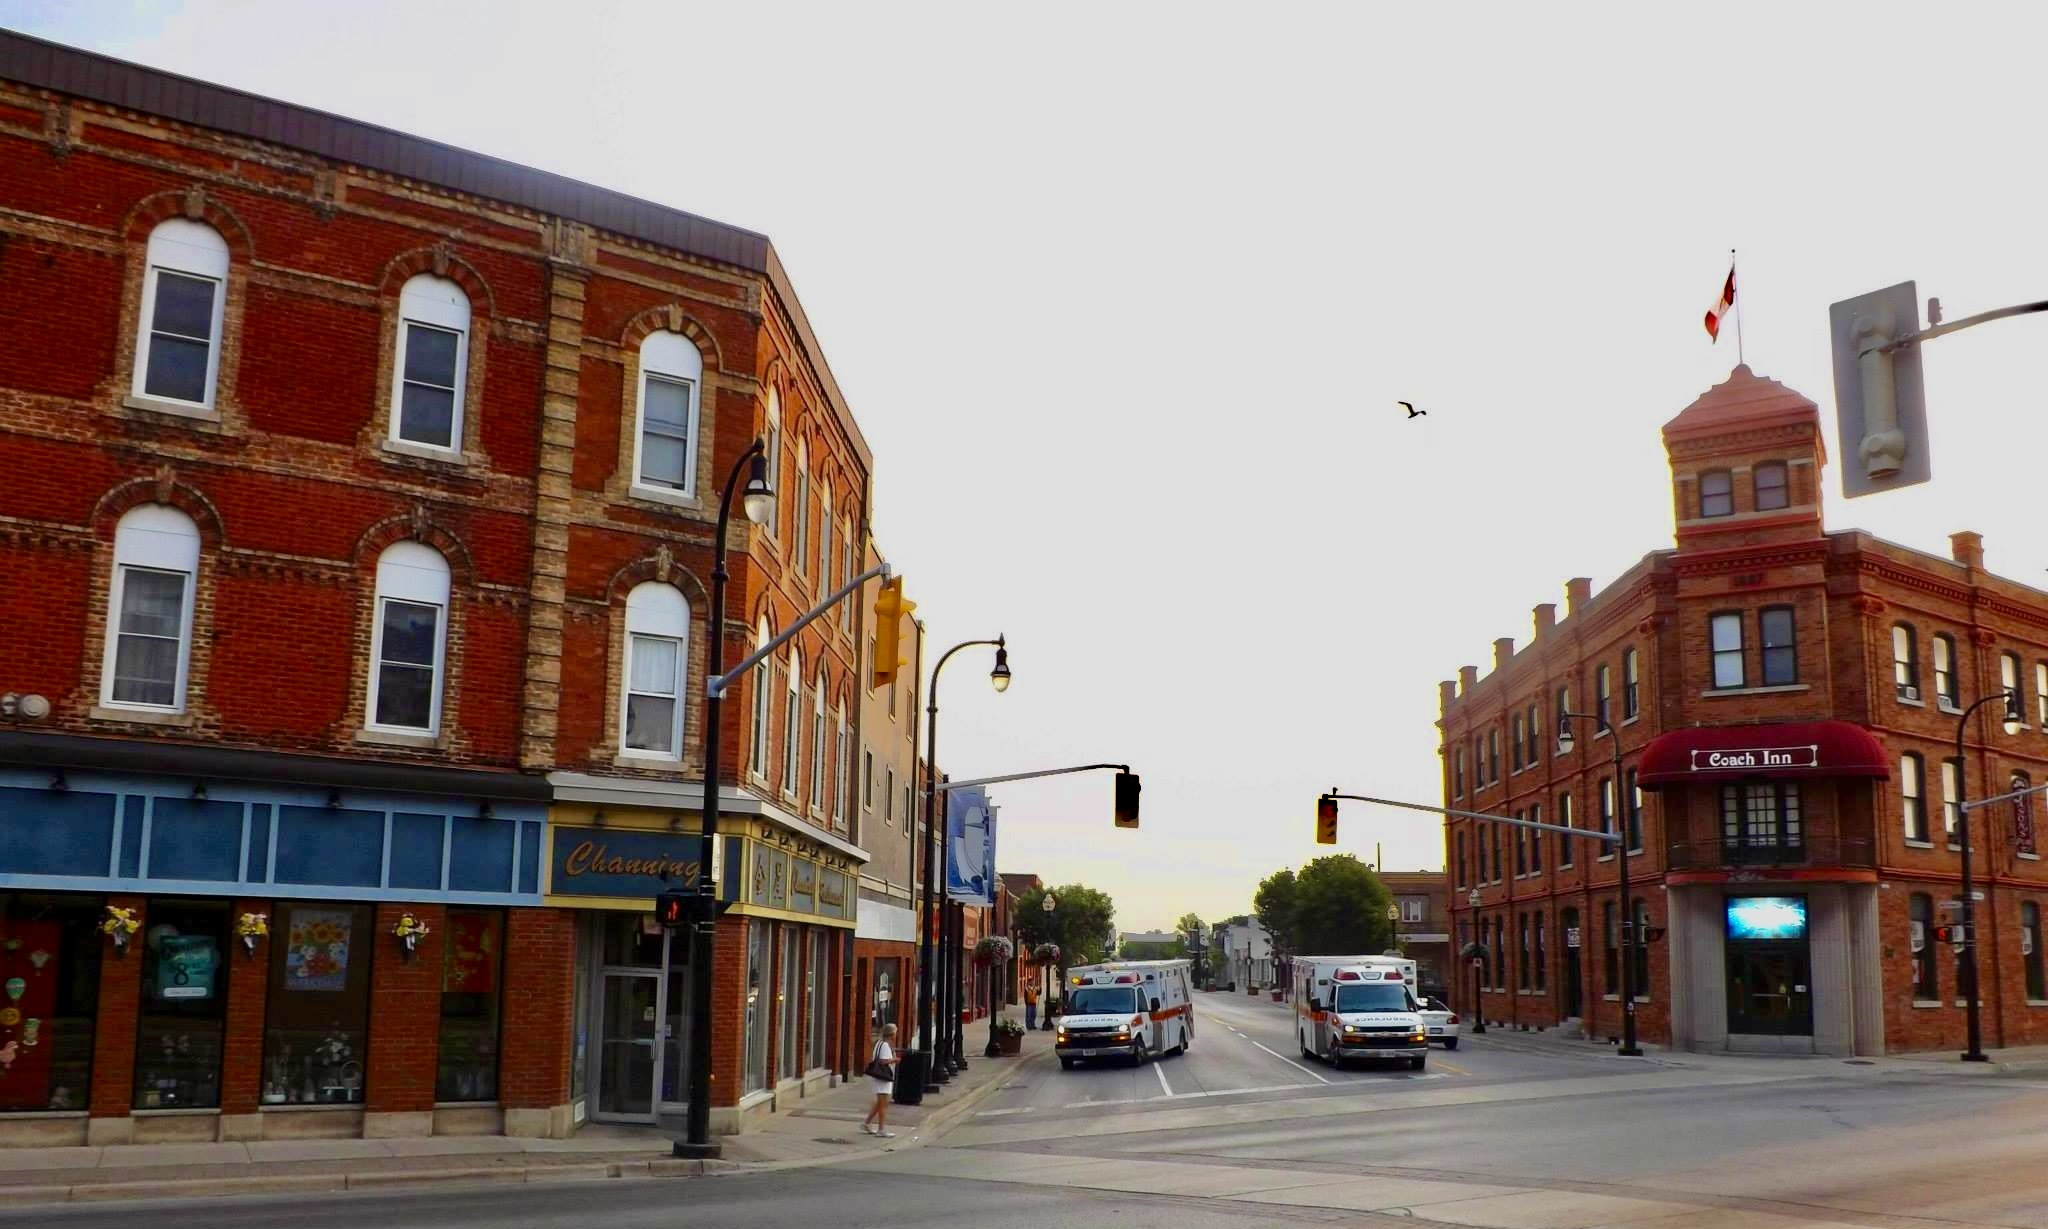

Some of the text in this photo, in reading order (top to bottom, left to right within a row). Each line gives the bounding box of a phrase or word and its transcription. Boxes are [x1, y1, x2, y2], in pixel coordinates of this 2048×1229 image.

[1709, 750, 1792, 766] Coach Inn
[565, 840, 701, 887] Channing
